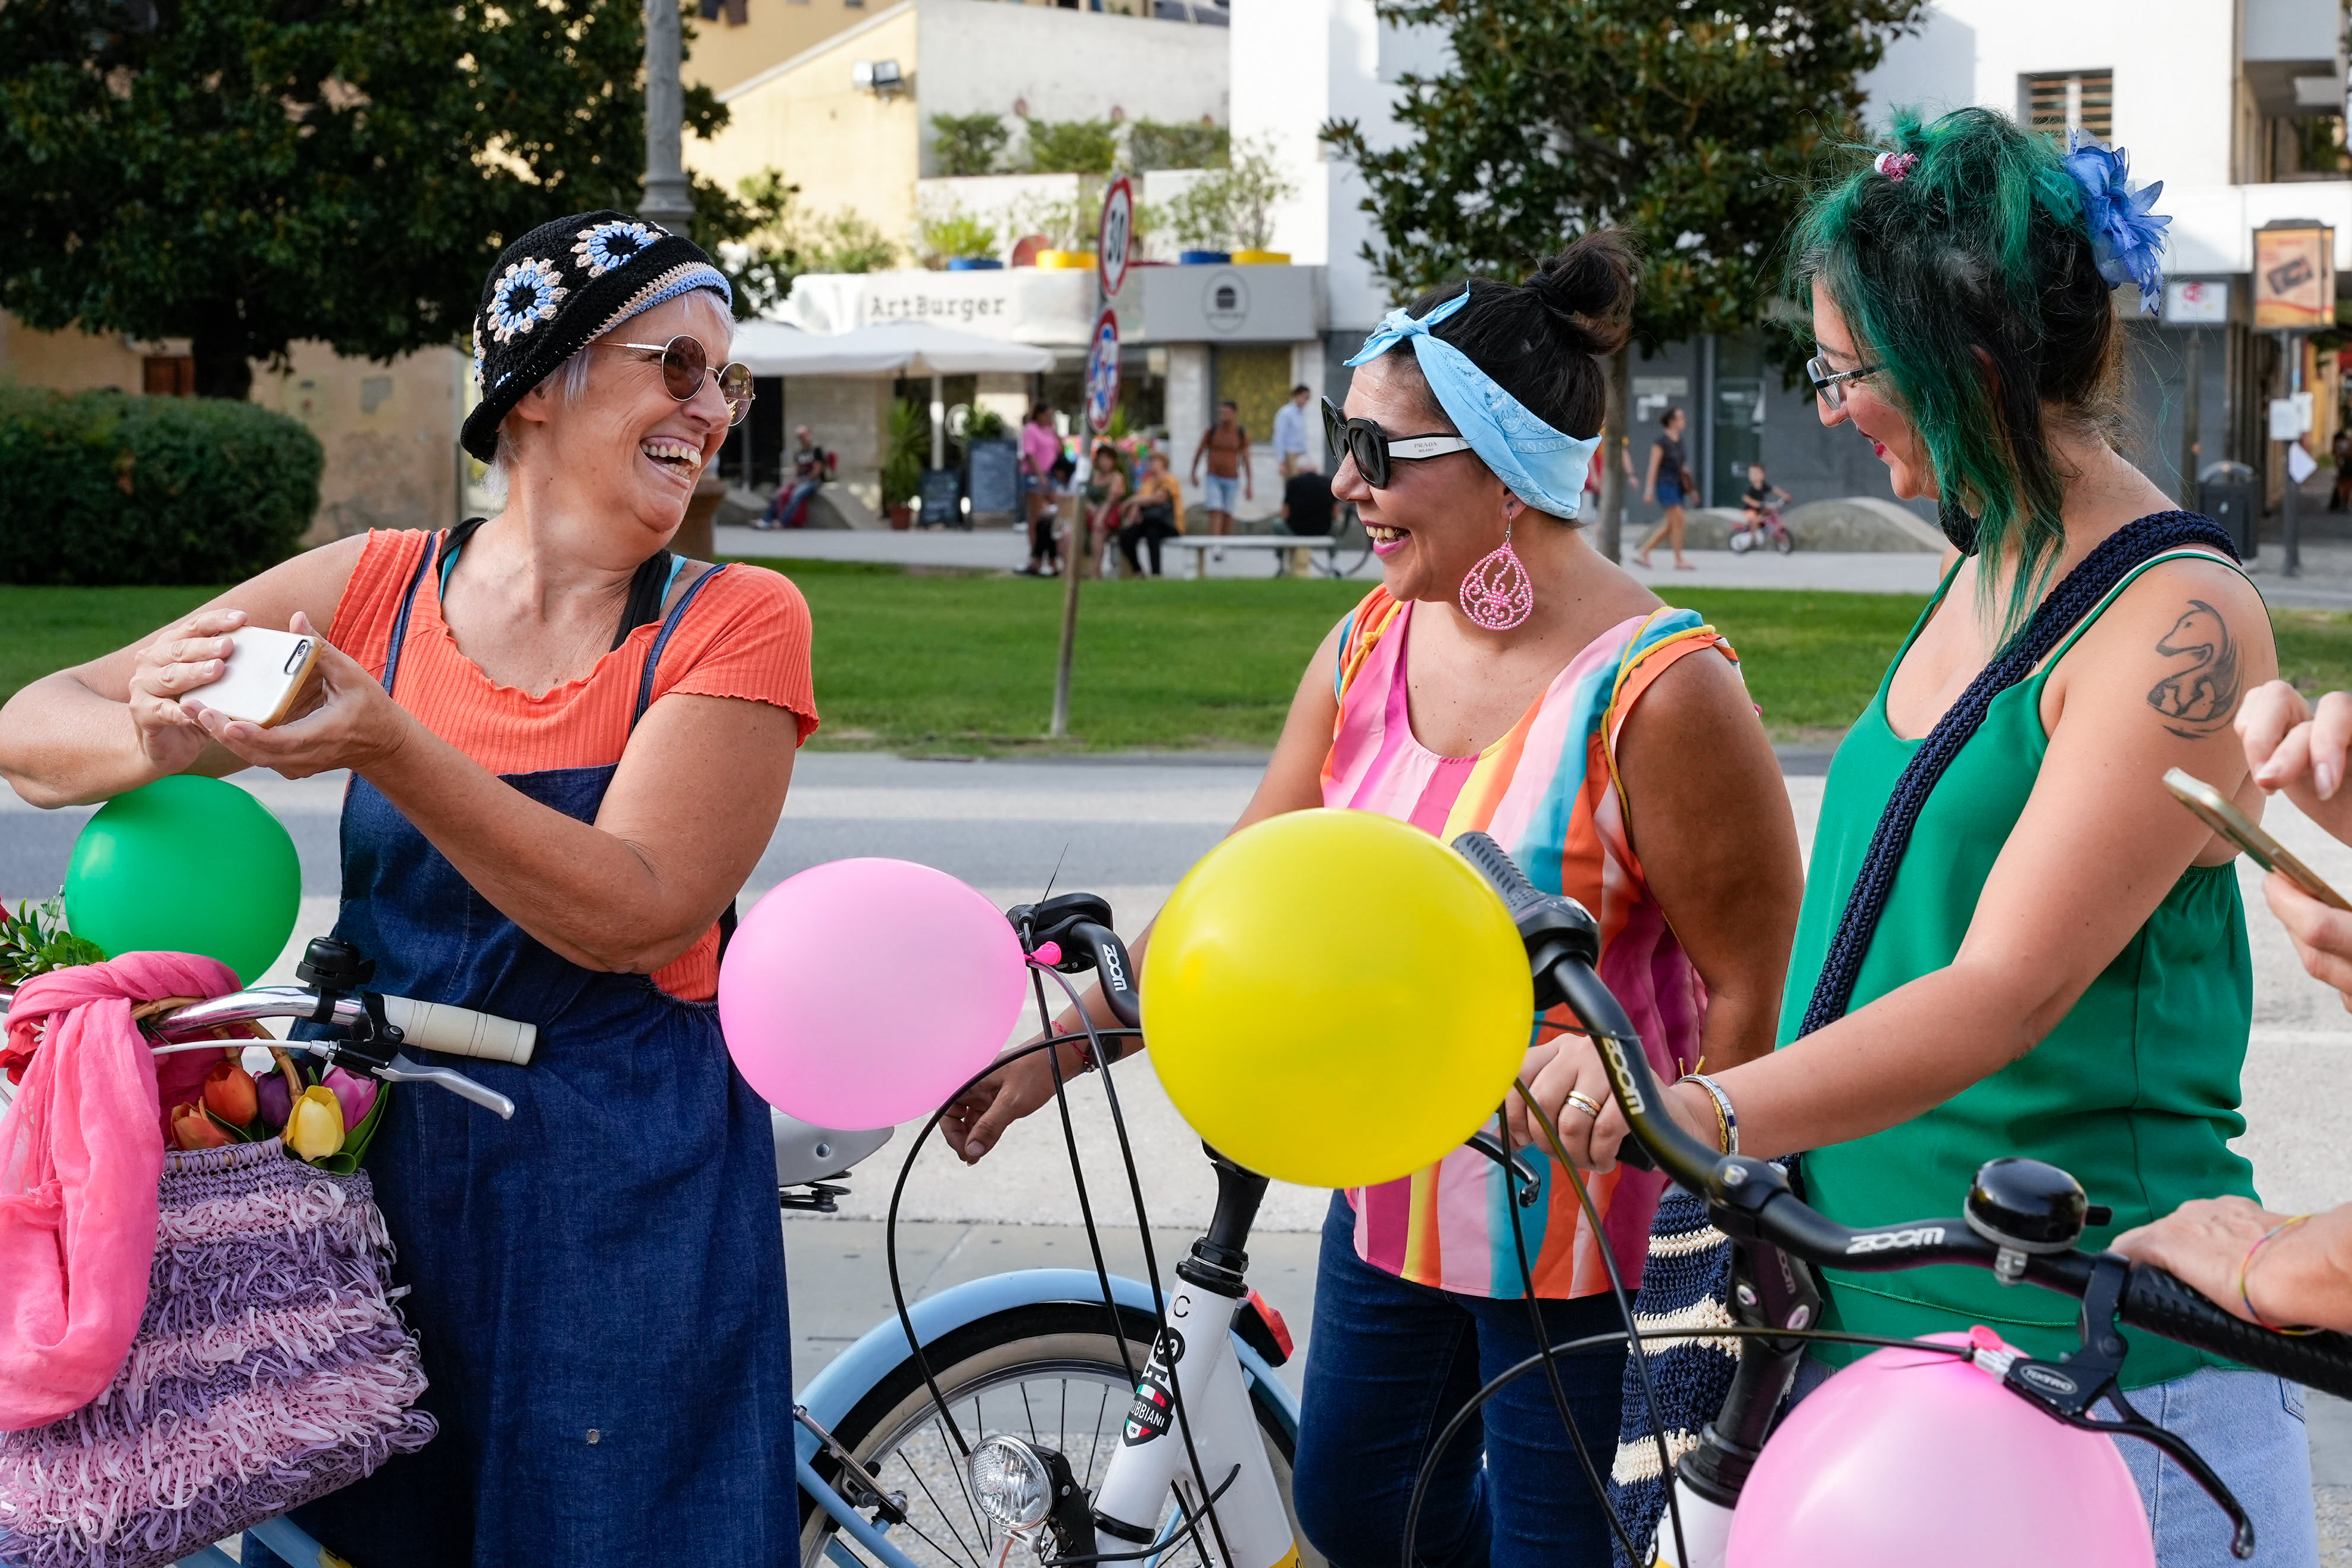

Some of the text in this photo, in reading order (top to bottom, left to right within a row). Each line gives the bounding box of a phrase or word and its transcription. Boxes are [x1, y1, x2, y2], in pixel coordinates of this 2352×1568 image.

[1107, 209, 1125, 263] 30
[870, 295, 1006, 322] ArtBurger
[1102, 944, 1128, 991] ZOOM
[1845, 1227, 1946, 1254] ZOOM
[1174, 1295, 1191, 1317] C
